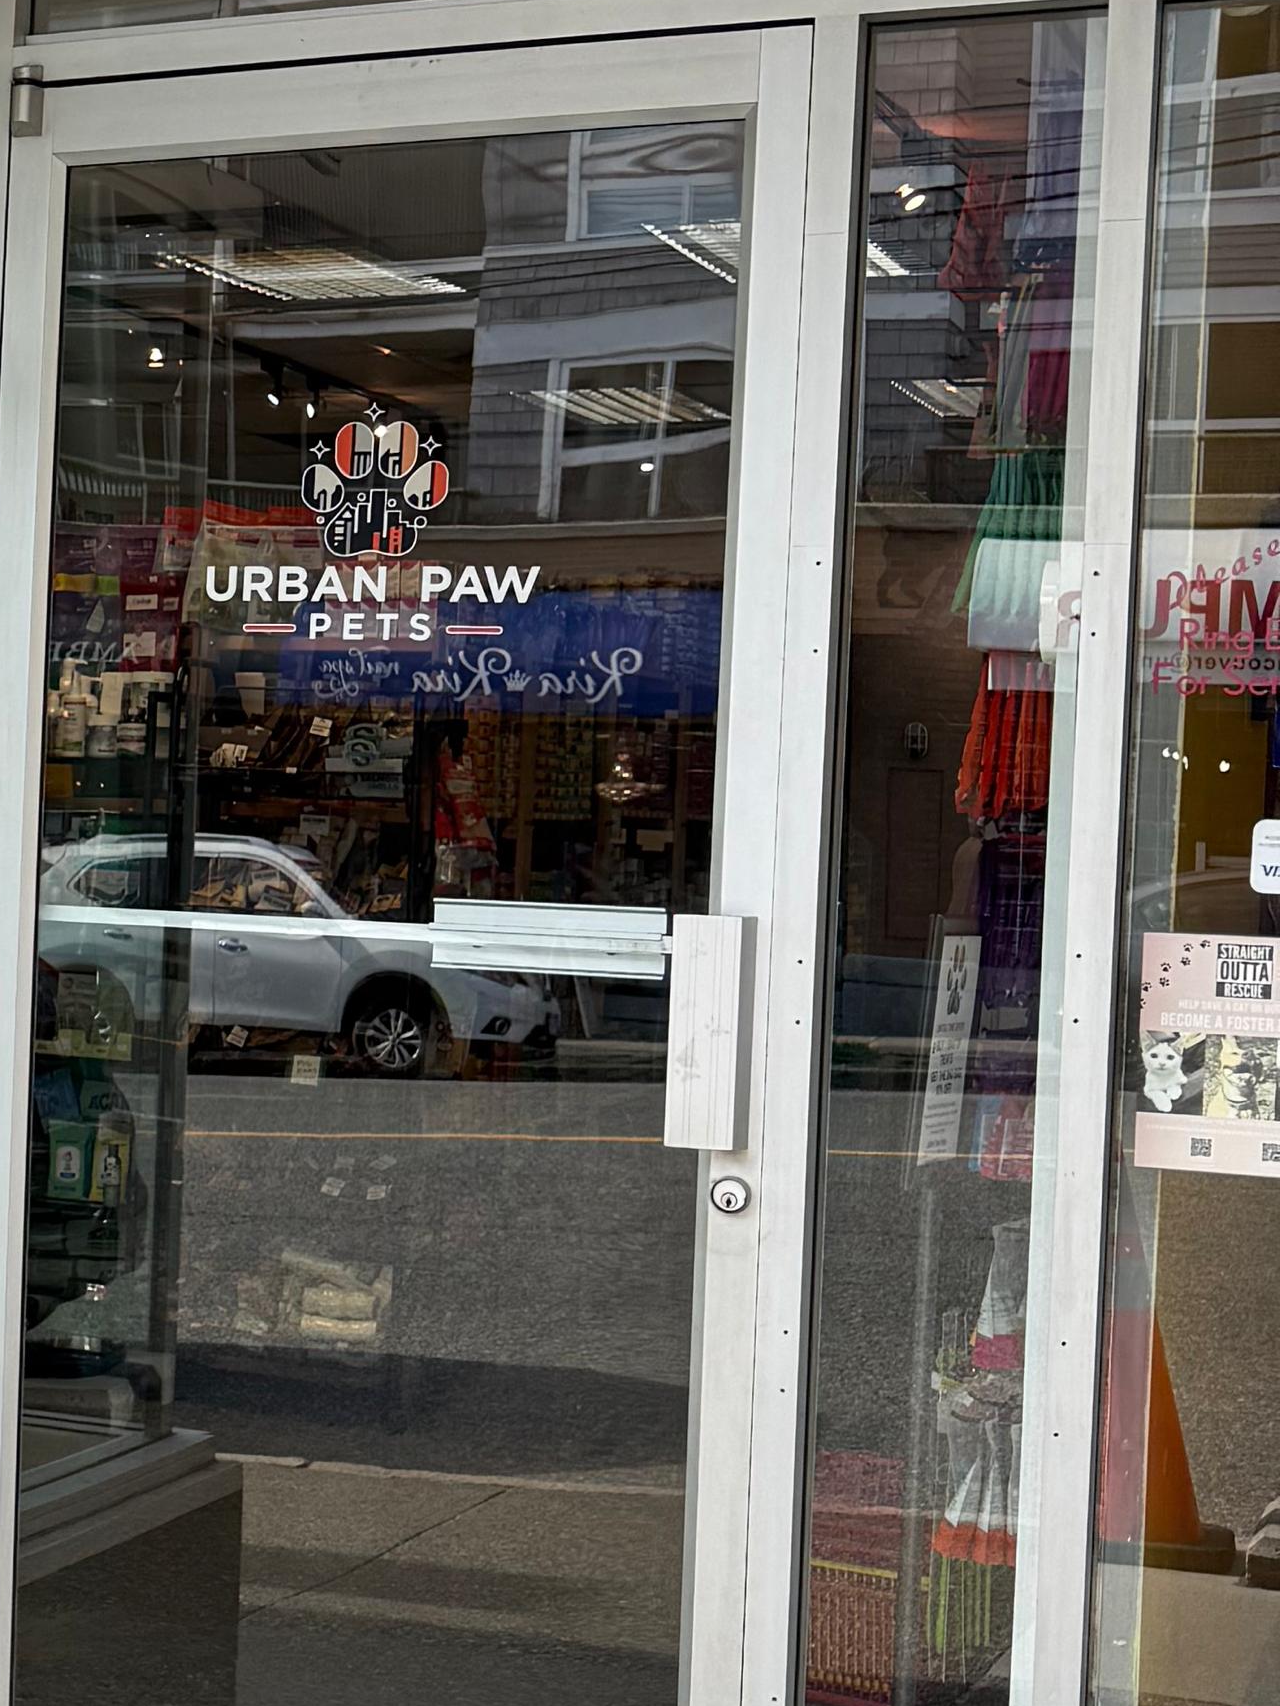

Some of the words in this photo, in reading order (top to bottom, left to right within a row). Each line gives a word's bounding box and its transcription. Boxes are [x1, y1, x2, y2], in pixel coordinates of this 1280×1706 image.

[205, 565, 387, 603] URBAN
[422, 565, 541, 604] PAW
[308, 612, 432, 641] PETS
[1178, 618, 1255, 659] Ring
[1152, 661, 1213, 697] For
[1261, 864, 1280, 877] VI
[1220, 944, 1271, 960] STRAIGHT
[1220, 960, 1269, 982] OUTTA
[1223, 983, 1264, 998] RESCUE
[1160, 1012, 1212, 1028] BECOME
[1214, 1014, 1224, 1029] A
[1227, 1014, 1273, 1031] FOSTER
